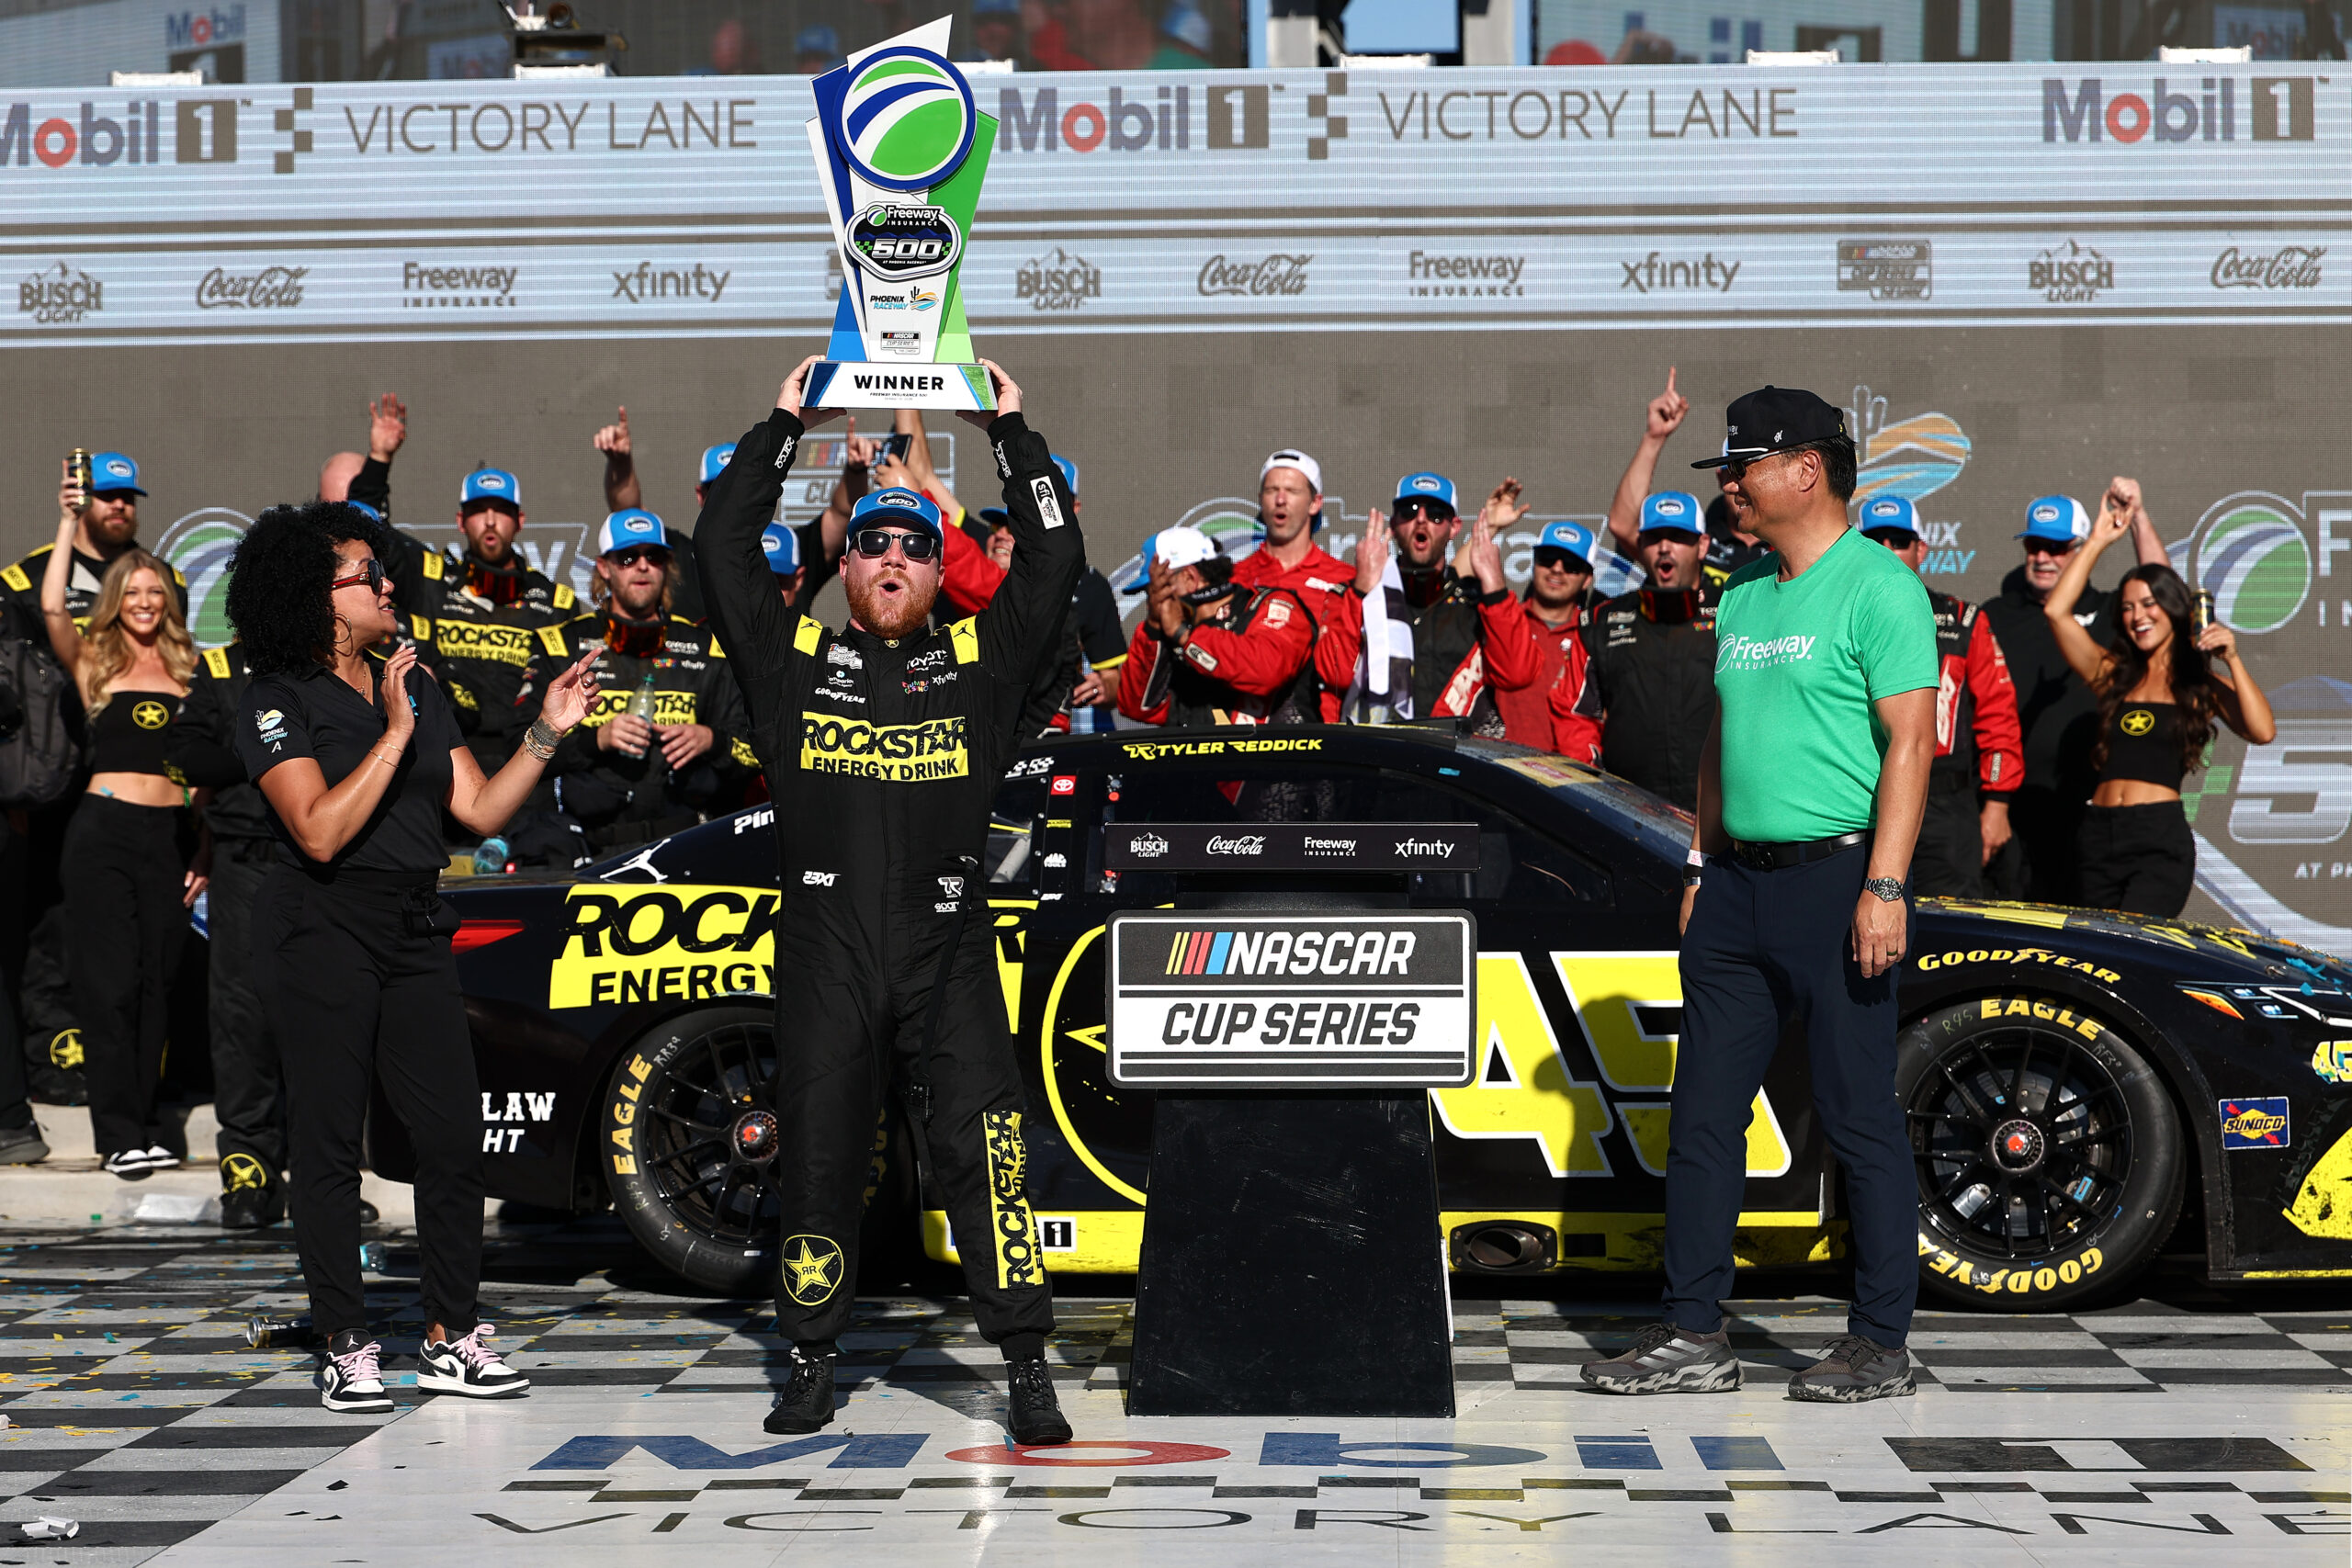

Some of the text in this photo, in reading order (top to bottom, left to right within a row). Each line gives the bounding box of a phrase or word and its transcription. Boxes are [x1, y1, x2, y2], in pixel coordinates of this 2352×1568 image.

[999, 85, 1190, 153] Mobil
[1378, 87, 1798, 141] VICTORY LANE
[2041, 77, 2235, 144] Mobil
[344, 99, 757, 153] VICTORY LANE
[888, 207, 938, 221] Freeway
[871, 239, 943, 259] 500
[403, 262, 517, 295] Freeway
[1197, 254, 1313, 295] Coca-Cola
[1408, 250, 1525, 284] Freeway
[1621, 251, 1741, 292] xfinity
[2029, 260, 2113, 289] BUSCH
[2211, 246, 2327, 288] Coca-Cola
[196, 266, 309, 309] Coca-Cola
[611, 261, 731, 303] xfinity
[1016, 267, 1101, 298] BUSCH
[1408, 285, 1525, 297] INSURANCE
[2044, 287, 2098, 302] LIGHT
[18, 280, 103, 311] BUSCH
[403, 297, 517, 307] INSURANCE
[870, 295, 905, 303] PHOENIX
[1034, 296, 1085, 310] LIGHT
[35, 310, 87, 323] LIGHT
[854, 375, 944, 390] WINNER
[1037, 482, 1050, 497] sfi
[886, 498, 914, 507] 500
[1732, 635, 1816, 660] Freeway
[1730, 654, 1795, 671] INSURANCE
[932, 671, 958, 686] xfinity
[815, 687, 866, 705] GOODYEAR
[260, 727, 285, 740] PHOENIX
[801, 718, 968, 760] ROCKSTAR
[1157, 742, 1225, 757] TYLER
[1227, 739, 1323, 752] REDDICK
[812, 756, 959, 781] ENERGY DRINK
[1130, 840, 1170, 853] BUSCH
[1205, 835, 1267, 855] Coca-Cola
[1304, 837, 1357, 852] Freeway
[1395, 838, 1455, 859] xfinity
[2294, 862, 2324, 878] AT
[1225, 931, 1417, 976] NASCAR
[1917, 948, 2121, 984] GOODYEAR
[1161, 1002, 1421, 1045] CUP SERIES
[1980, 994, 2106, 1042] EAGLE
[2312, 1039, 2352, 1083] 45
[611, 1053, 654, 1177] EAGLE
[2226, 1117, 2284, 1132] SUNOCO
[528, 1431, 1786, 1471] Mobil
[470, 1506, 2352, 1536] VICTORY LANE
